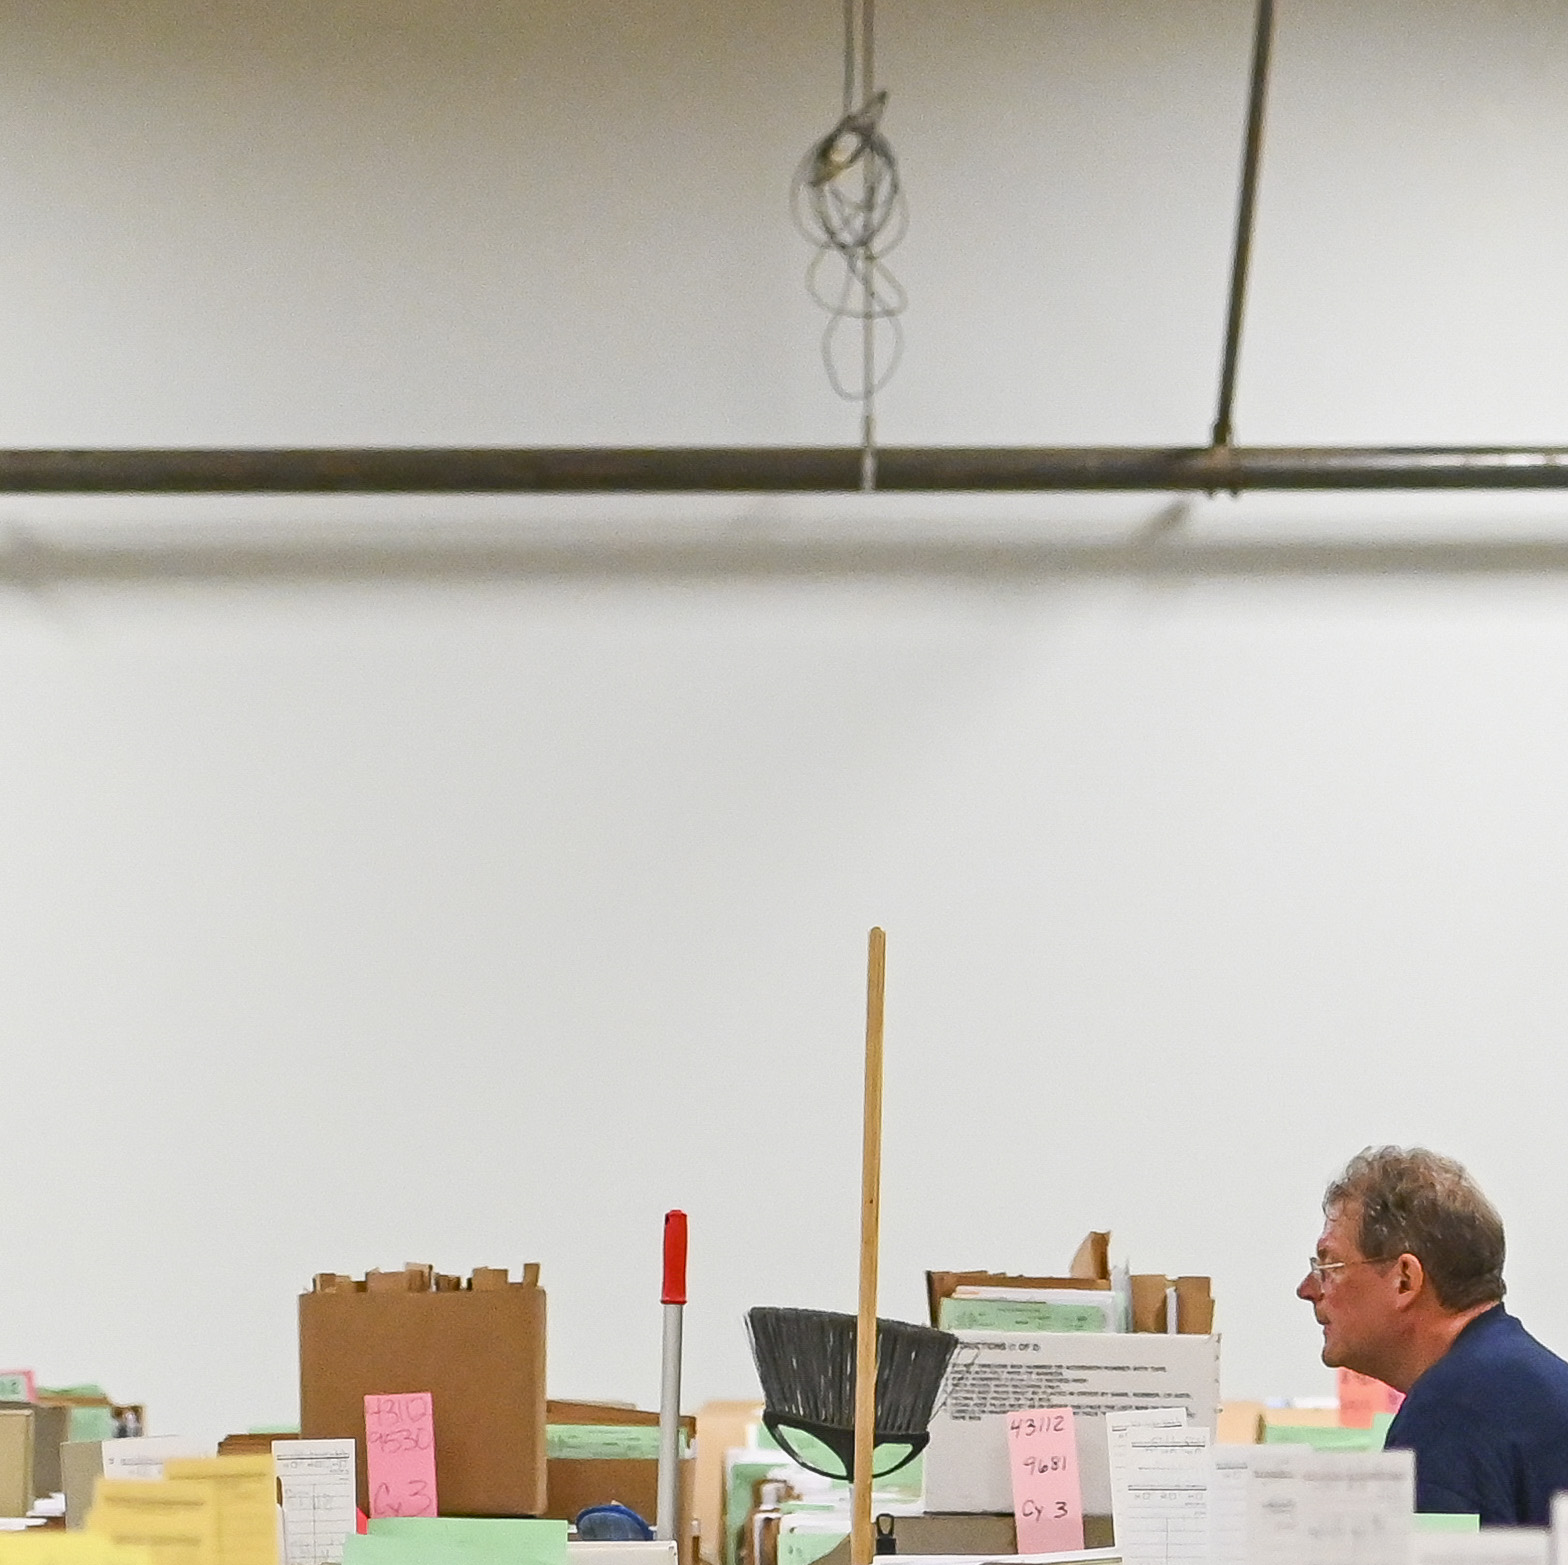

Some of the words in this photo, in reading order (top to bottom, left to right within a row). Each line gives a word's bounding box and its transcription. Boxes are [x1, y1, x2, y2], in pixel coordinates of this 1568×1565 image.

[1010, 1415, 1065, 1438] 43112
[1022, 1456, 1067, 1475] 9681
[408, 1480, 432, 1517] 3
[1022, 1499, 1044, 1522] Cy
[1053, 1501, 1069, 1519] 3
